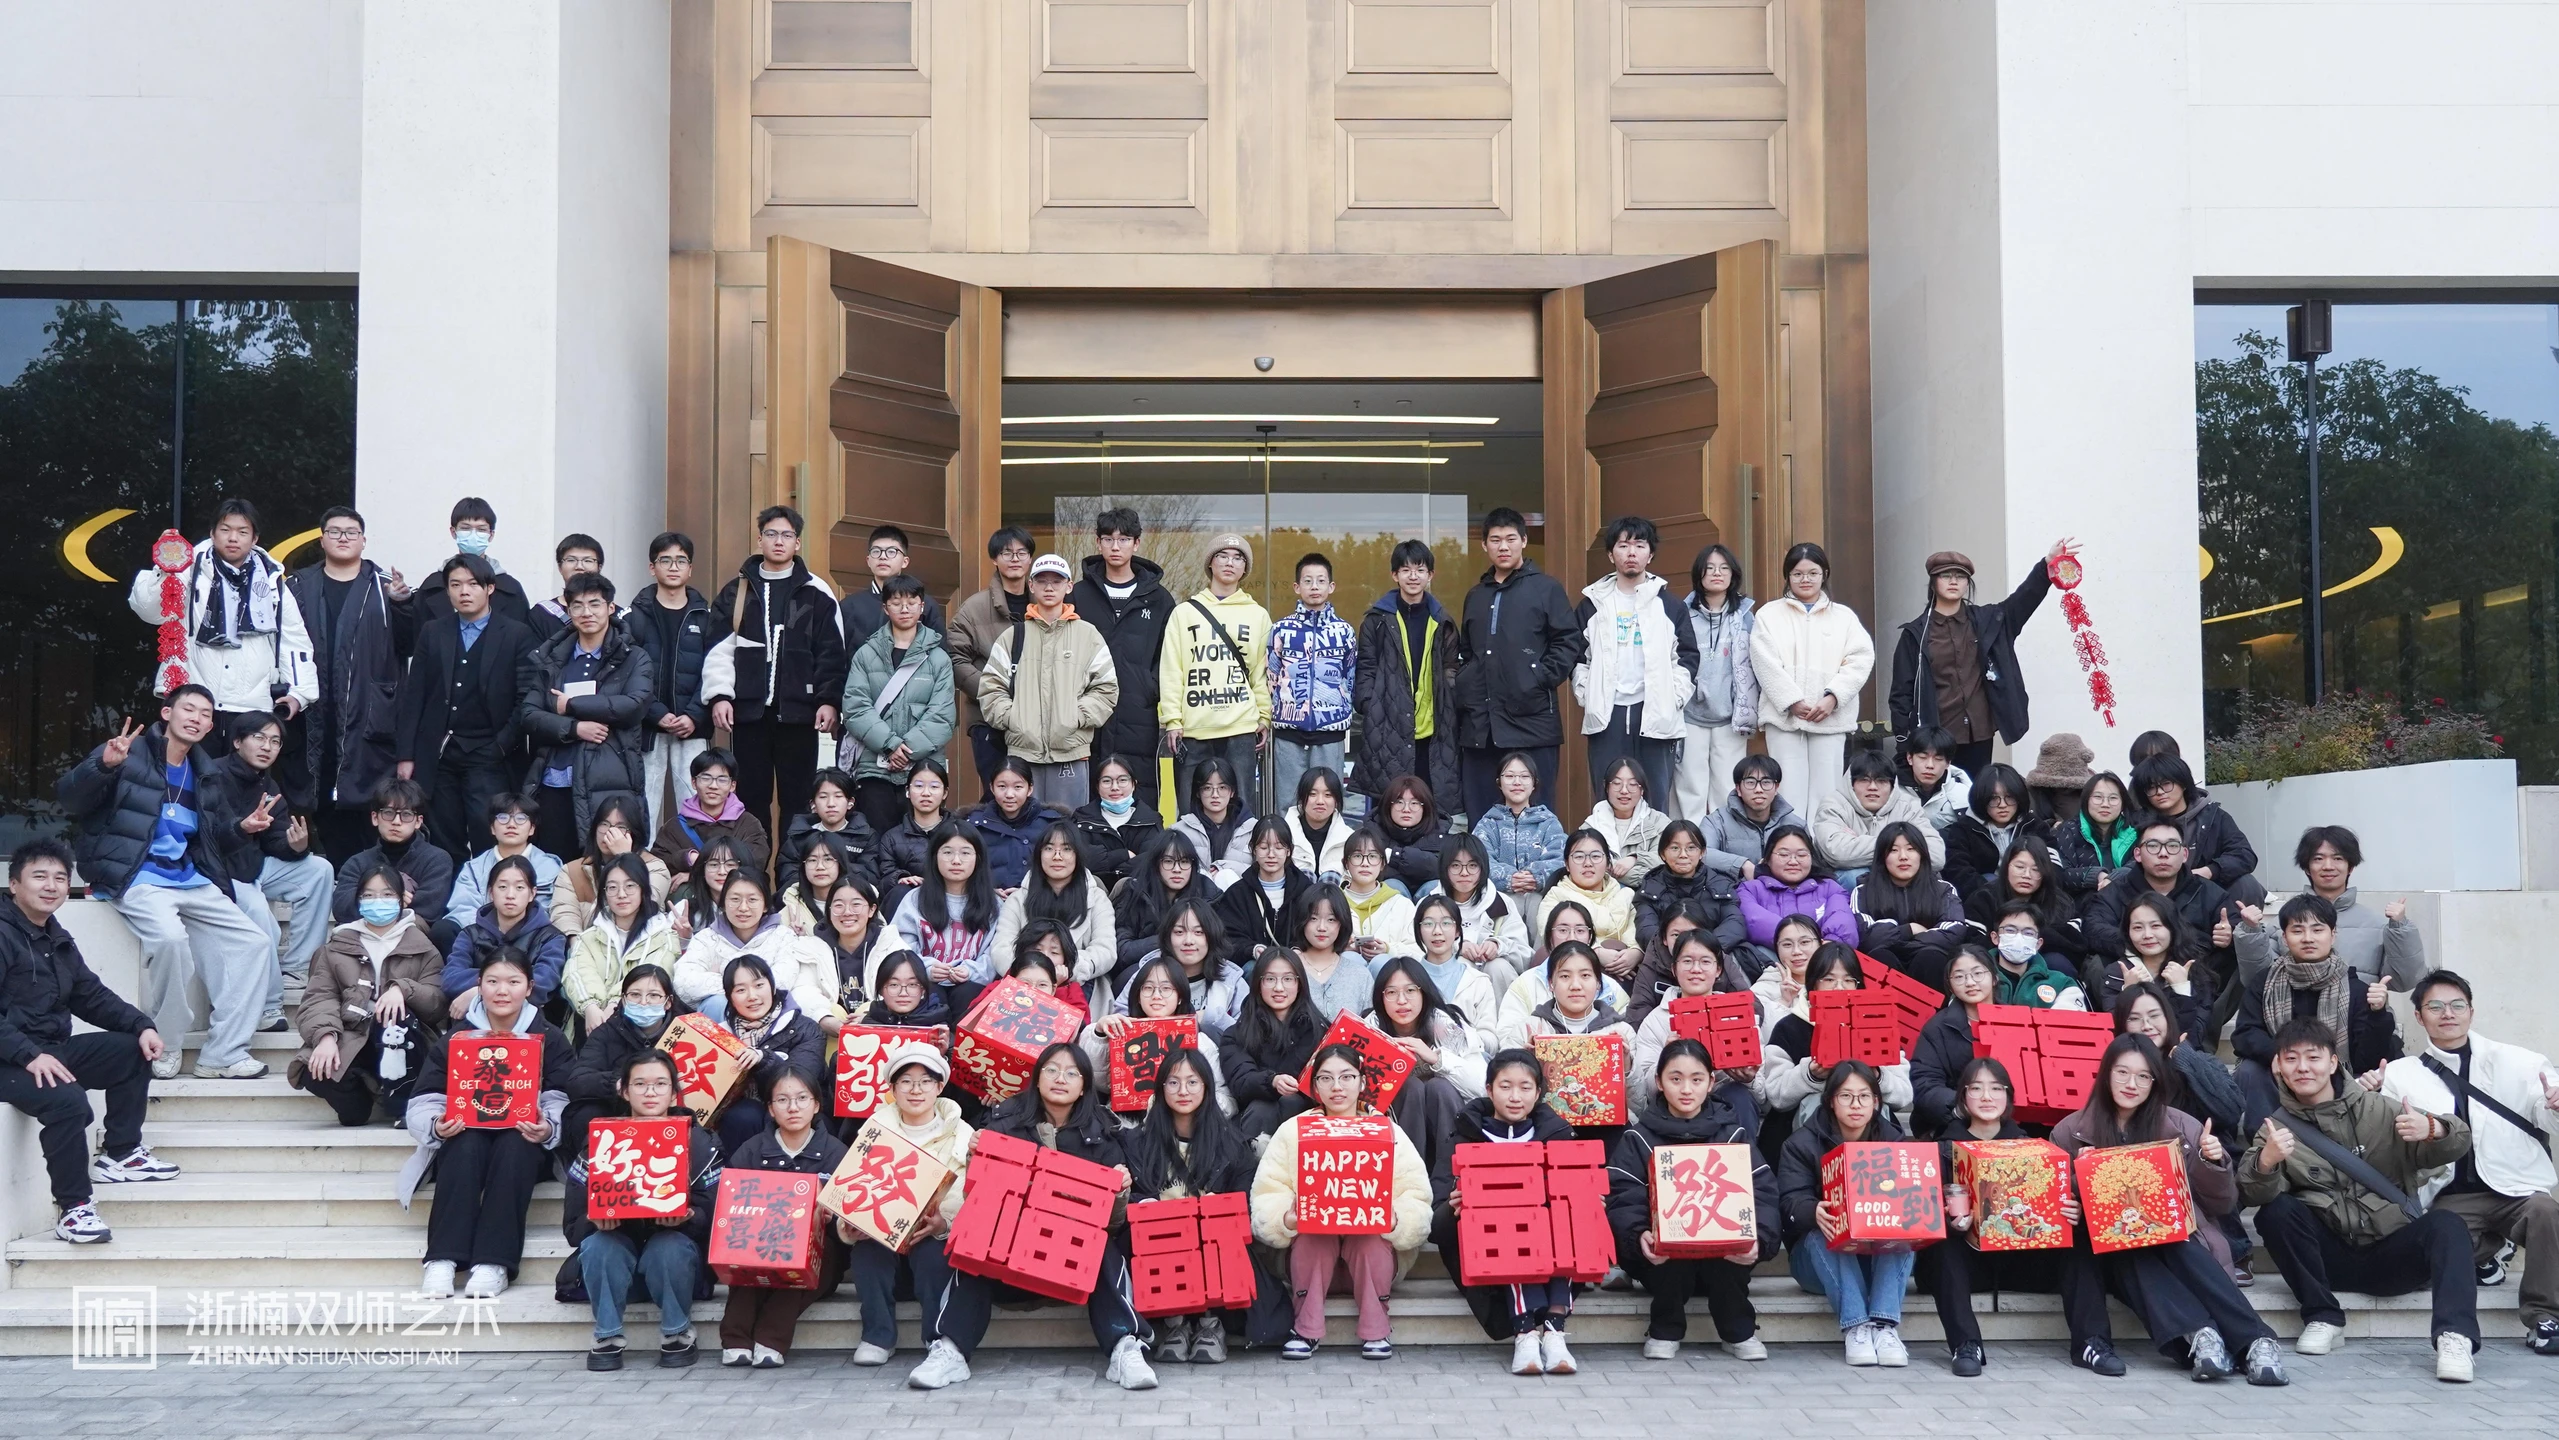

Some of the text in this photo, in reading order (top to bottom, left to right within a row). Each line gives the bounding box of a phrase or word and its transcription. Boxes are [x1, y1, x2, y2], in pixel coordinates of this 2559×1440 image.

[1187, 668, 1211, 687] ER
[1186, 686, 1250, 707] ONLINE
[999, 1007, 1020, 1017] HAPPY
[460, 1080, 532, 1090] GET RICH
[857, 1127, 882, 1156] 财神
[588, 1129, 687, 1213] 好运
[1303, 1150, 1390, 1172] HAPPY
[1660, 1150, 1677, 1181] 财神
[1821, 1153, 1845, 1186] HAPPY
[591, 1181, 636, 1193] GOOD
[733, 1178, 797, 1218] 平安
[1324, 1177, 1379, 1199] NEW
[1851, 1146, 1942, 1232] 福到
[597, 1194, 640, 1208] LUCK
[729, 1205, 768, 1216] HAPPY
[1854, 1201, 1891, 1214] GOOD
[944, 1130, 1125, 1299] 福
[1319, 1206, 1386, 1226] YEAR
[1738, 1207, 1755, 1238] 财运
